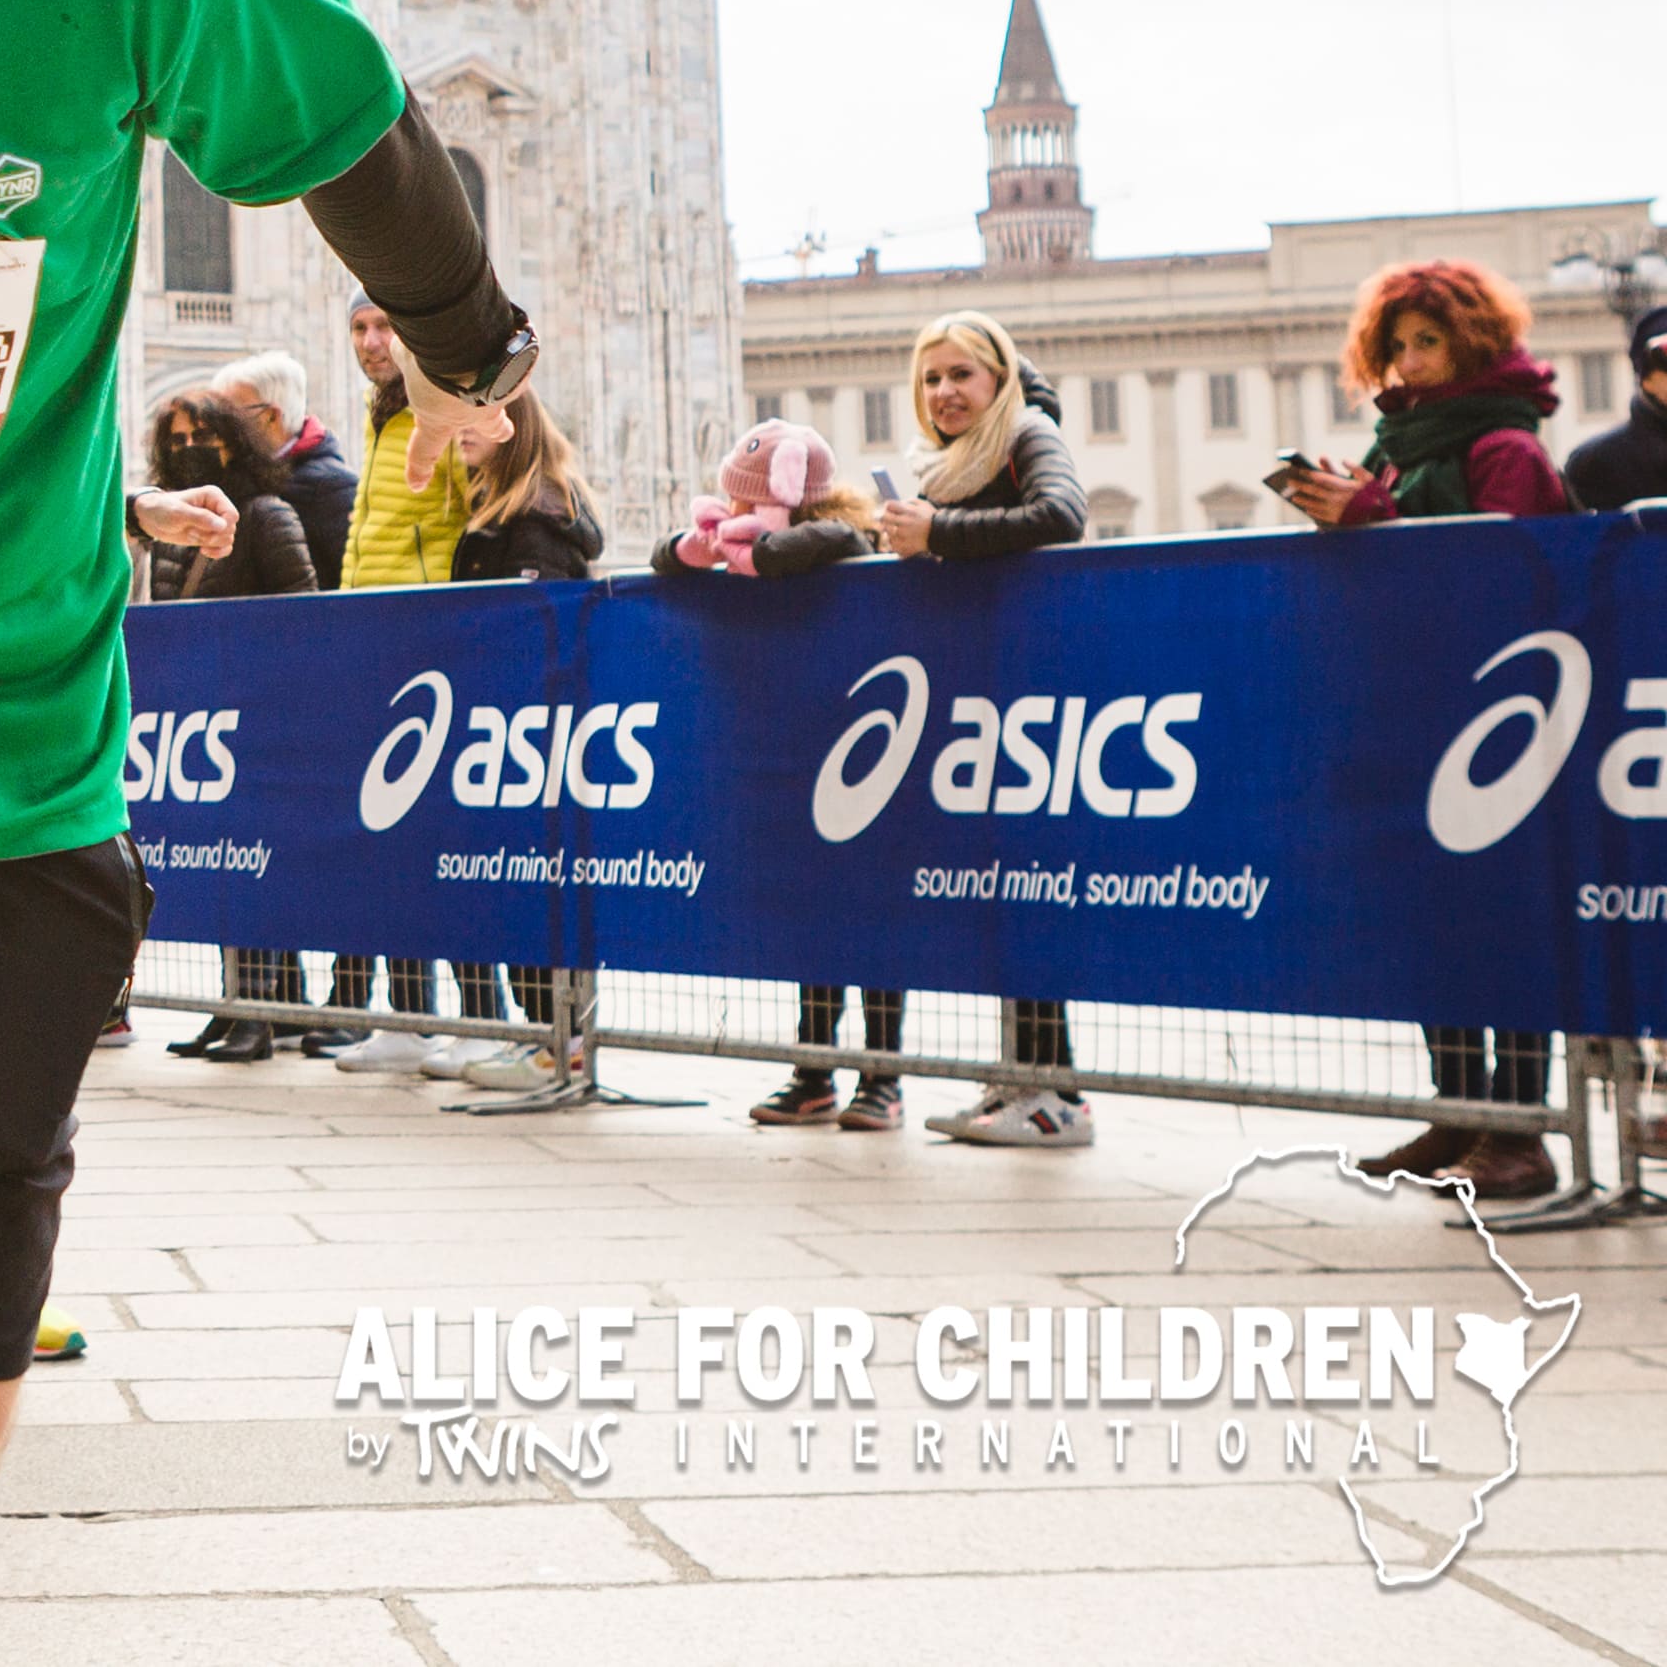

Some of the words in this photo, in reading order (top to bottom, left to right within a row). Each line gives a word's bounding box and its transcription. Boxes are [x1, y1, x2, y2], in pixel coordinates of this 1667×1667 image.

[170, 837, 224, 870] sound
[224, 837, 272, 880] body
[436, 847, 503, 882] sound
[506, 847, 567, 888] mind,
[572, 850, 641, 888] sound
[643, 850, 706, 897] body
[913, 860, 1000, 903] sound
[1002, 860, 1079, 909] mind,
[1084, 864, 1183, 909] sound
[1184, 864, 1270, 920] body
